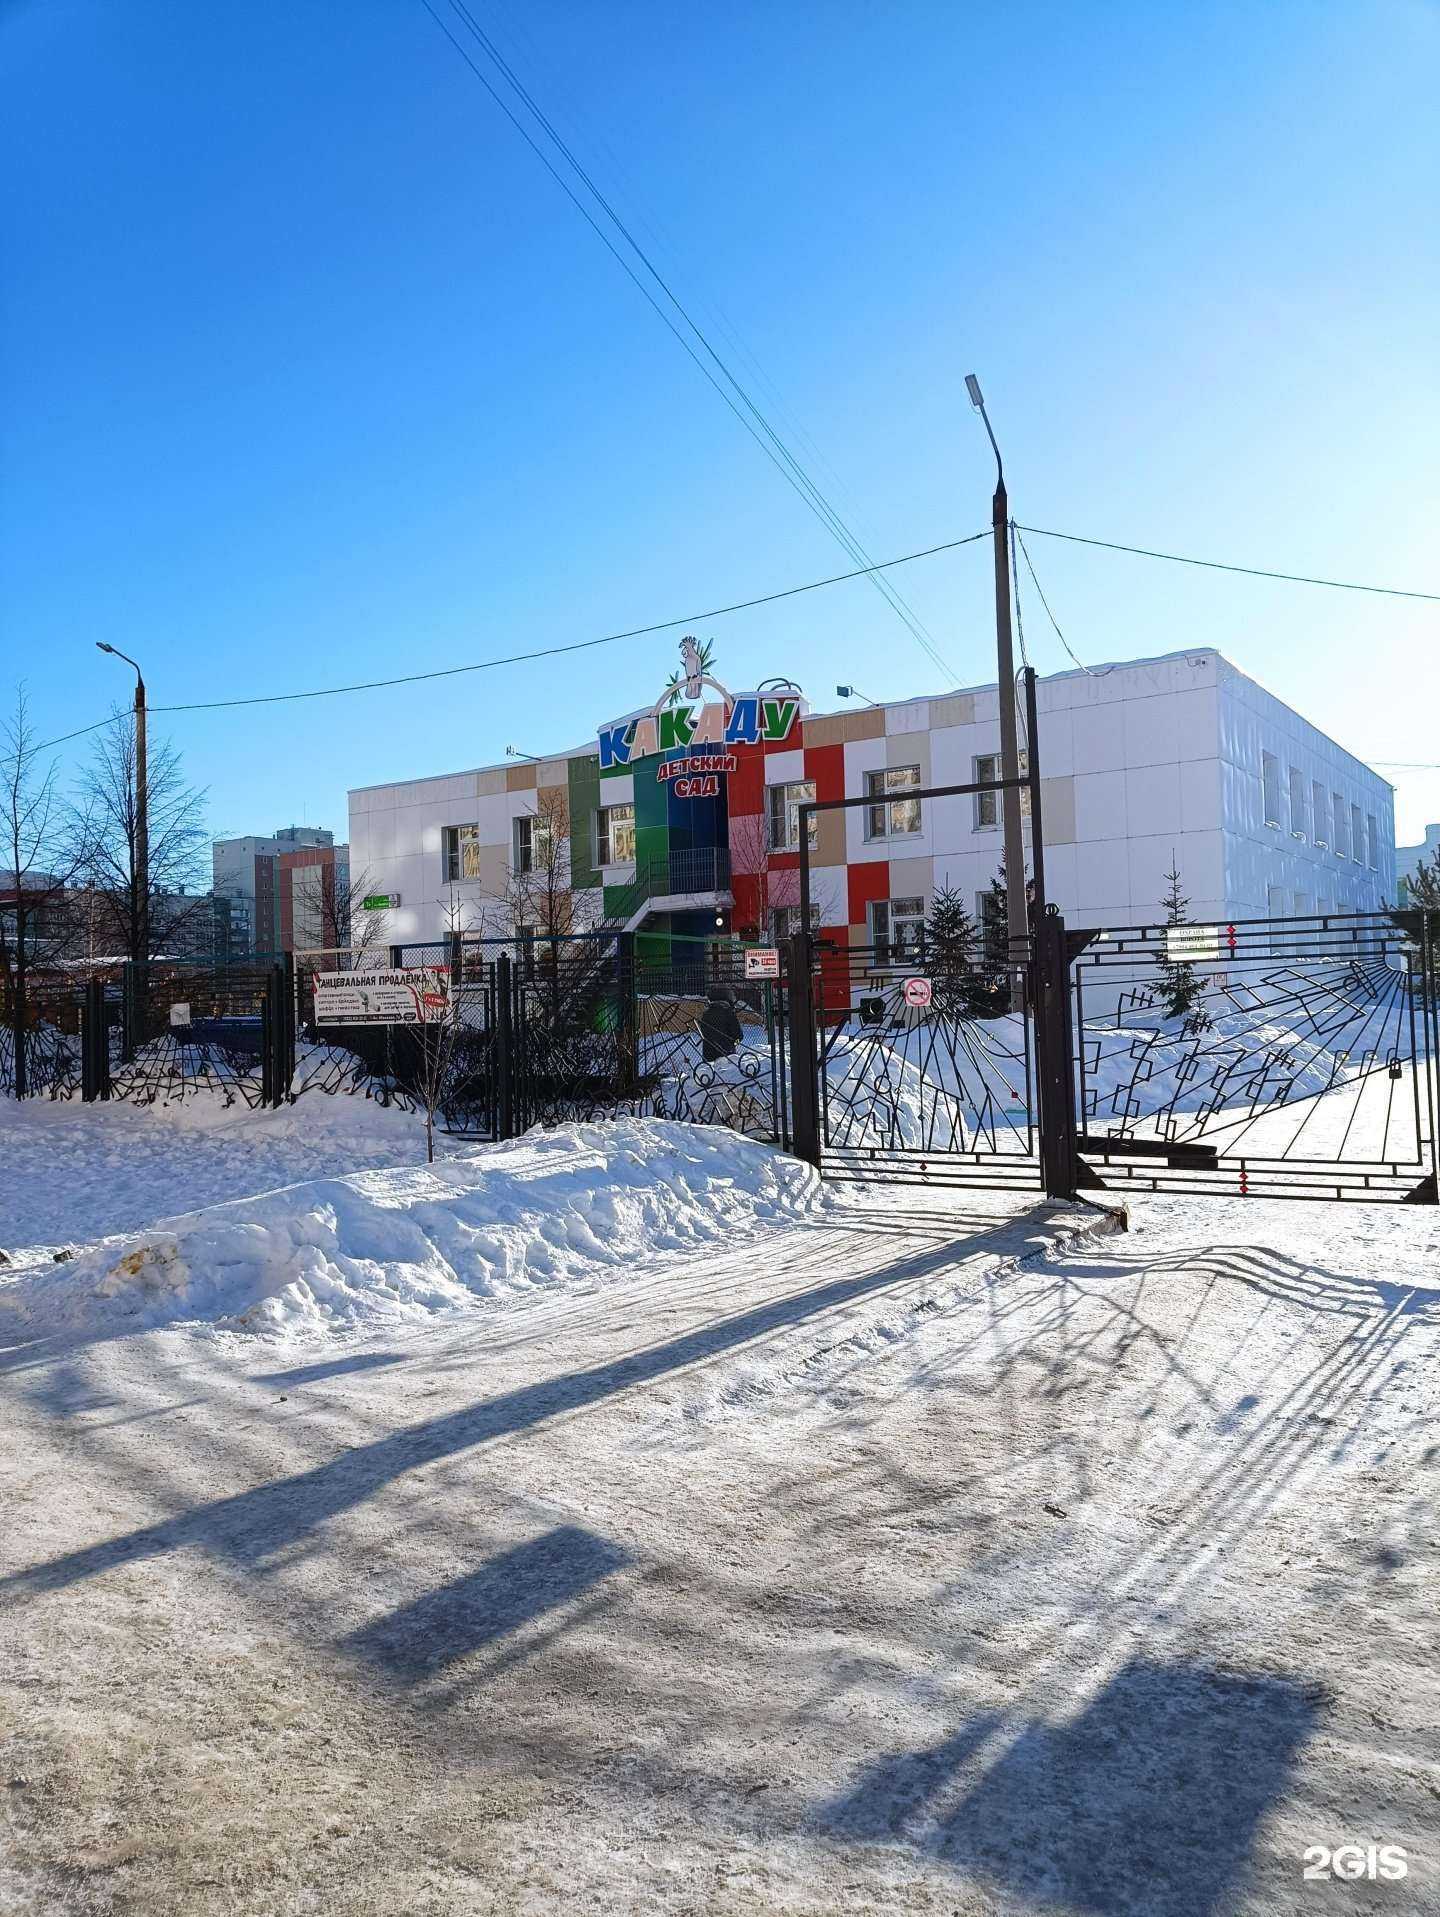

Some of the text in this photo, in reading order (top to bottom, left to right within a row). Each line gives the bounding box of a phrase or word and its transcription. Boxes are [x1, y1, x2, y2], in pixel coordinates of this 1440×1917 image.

[599, 698, 800, 769] КАКАДУ
[657, 753, 738, 782] ДЕТСКИЙ
[674, 775, 720, 798] САД
[319, 976, 376, 989] ТАНЦЕВАЛЬНАЯ
